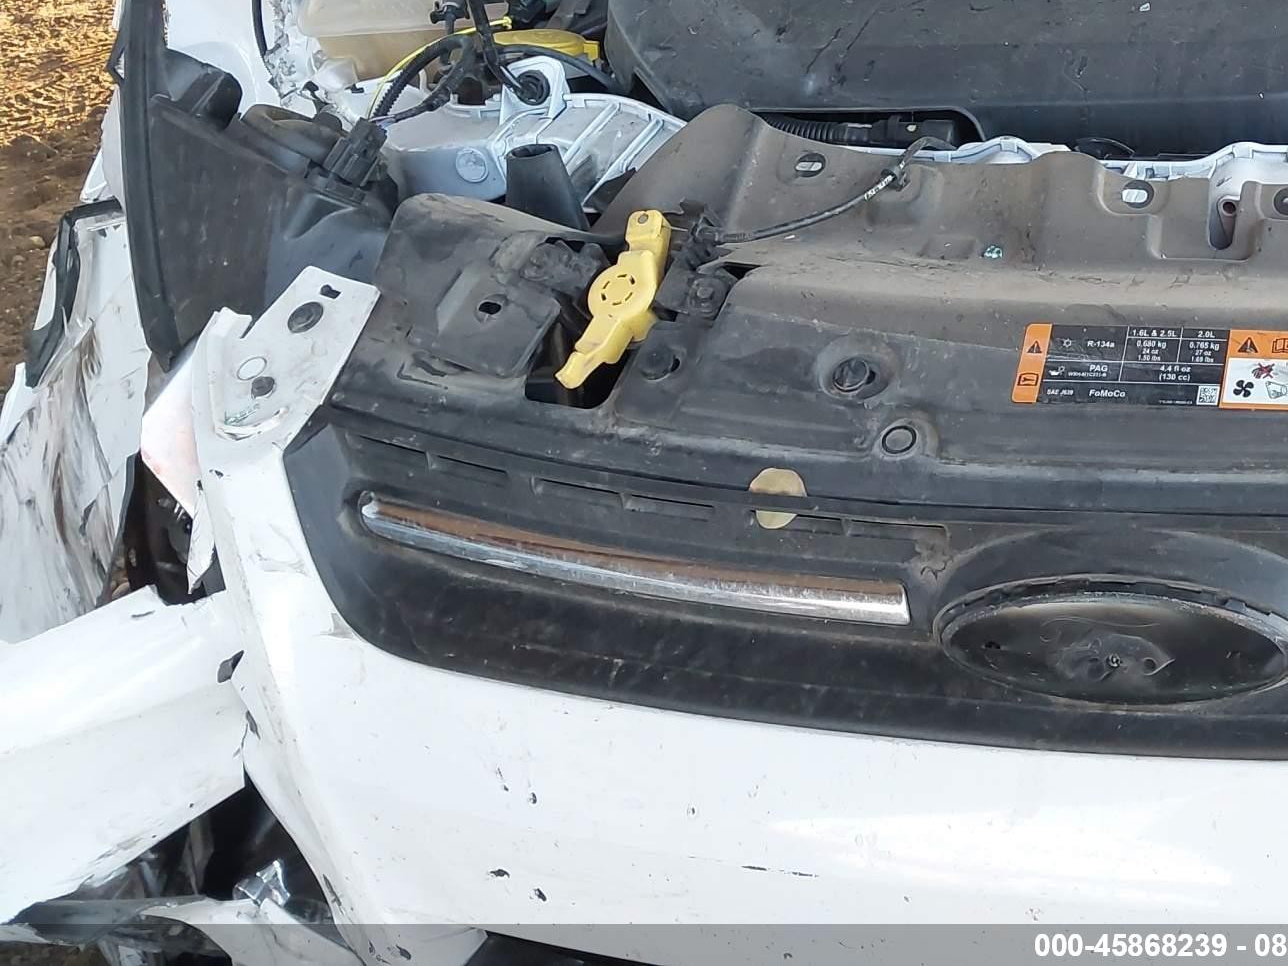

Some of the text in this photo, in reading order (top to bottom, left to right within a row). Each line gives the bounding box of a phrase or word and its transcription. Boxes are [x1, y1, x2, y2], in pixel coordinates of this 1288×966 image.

[1087, 340, 1115, 348] R-134a
[1157, 341, 1167, 349] kg
[1210, 342, 1220, 351] kg
[1159, 373, 1176, 381] (130
[1089, 389, 1126, 397] FoMoCo
